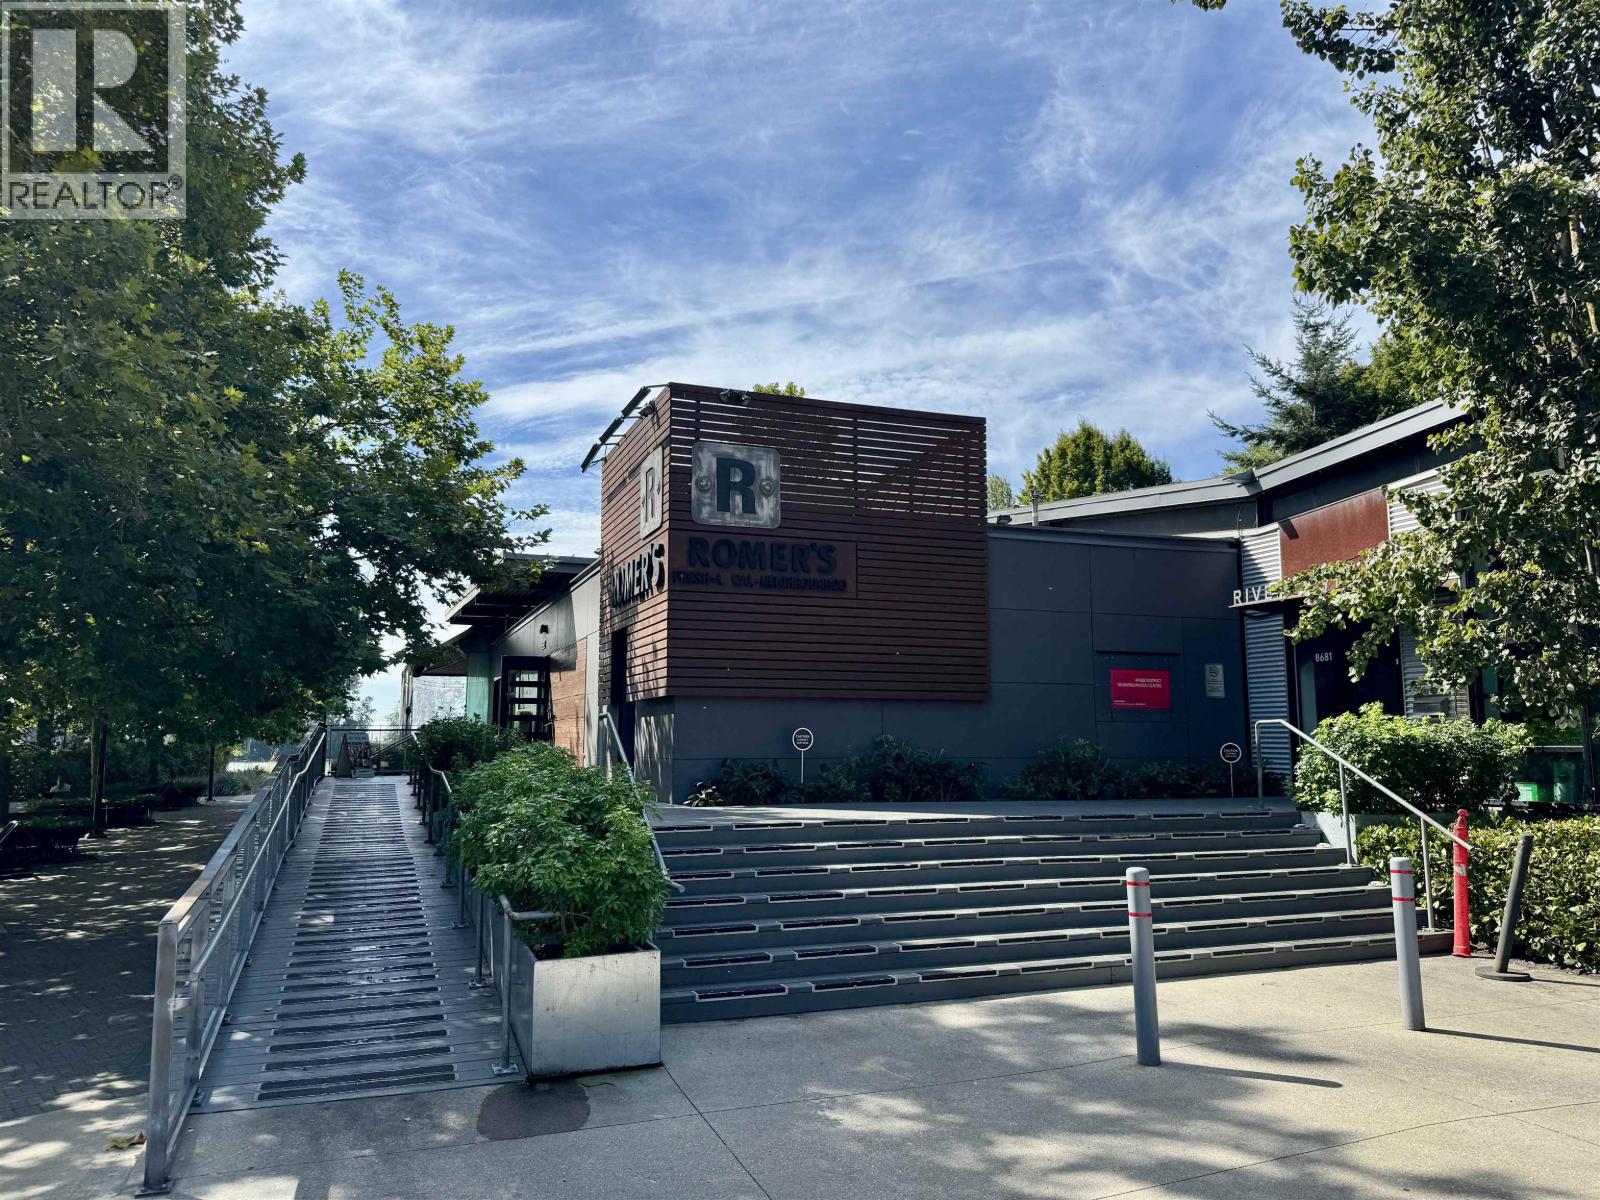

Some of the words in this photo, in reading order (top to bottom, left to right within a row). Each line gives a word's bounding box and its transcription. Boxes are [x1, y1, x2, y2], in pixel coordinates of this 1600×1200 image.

[645, 467, 656, 522] R
[715, 456, 757, 515] R
[688, 537, 838, 575] ROMER'S
[1233, 586, 1284, 606] RIVE
[1314, 651, 1334, 663] 8681
